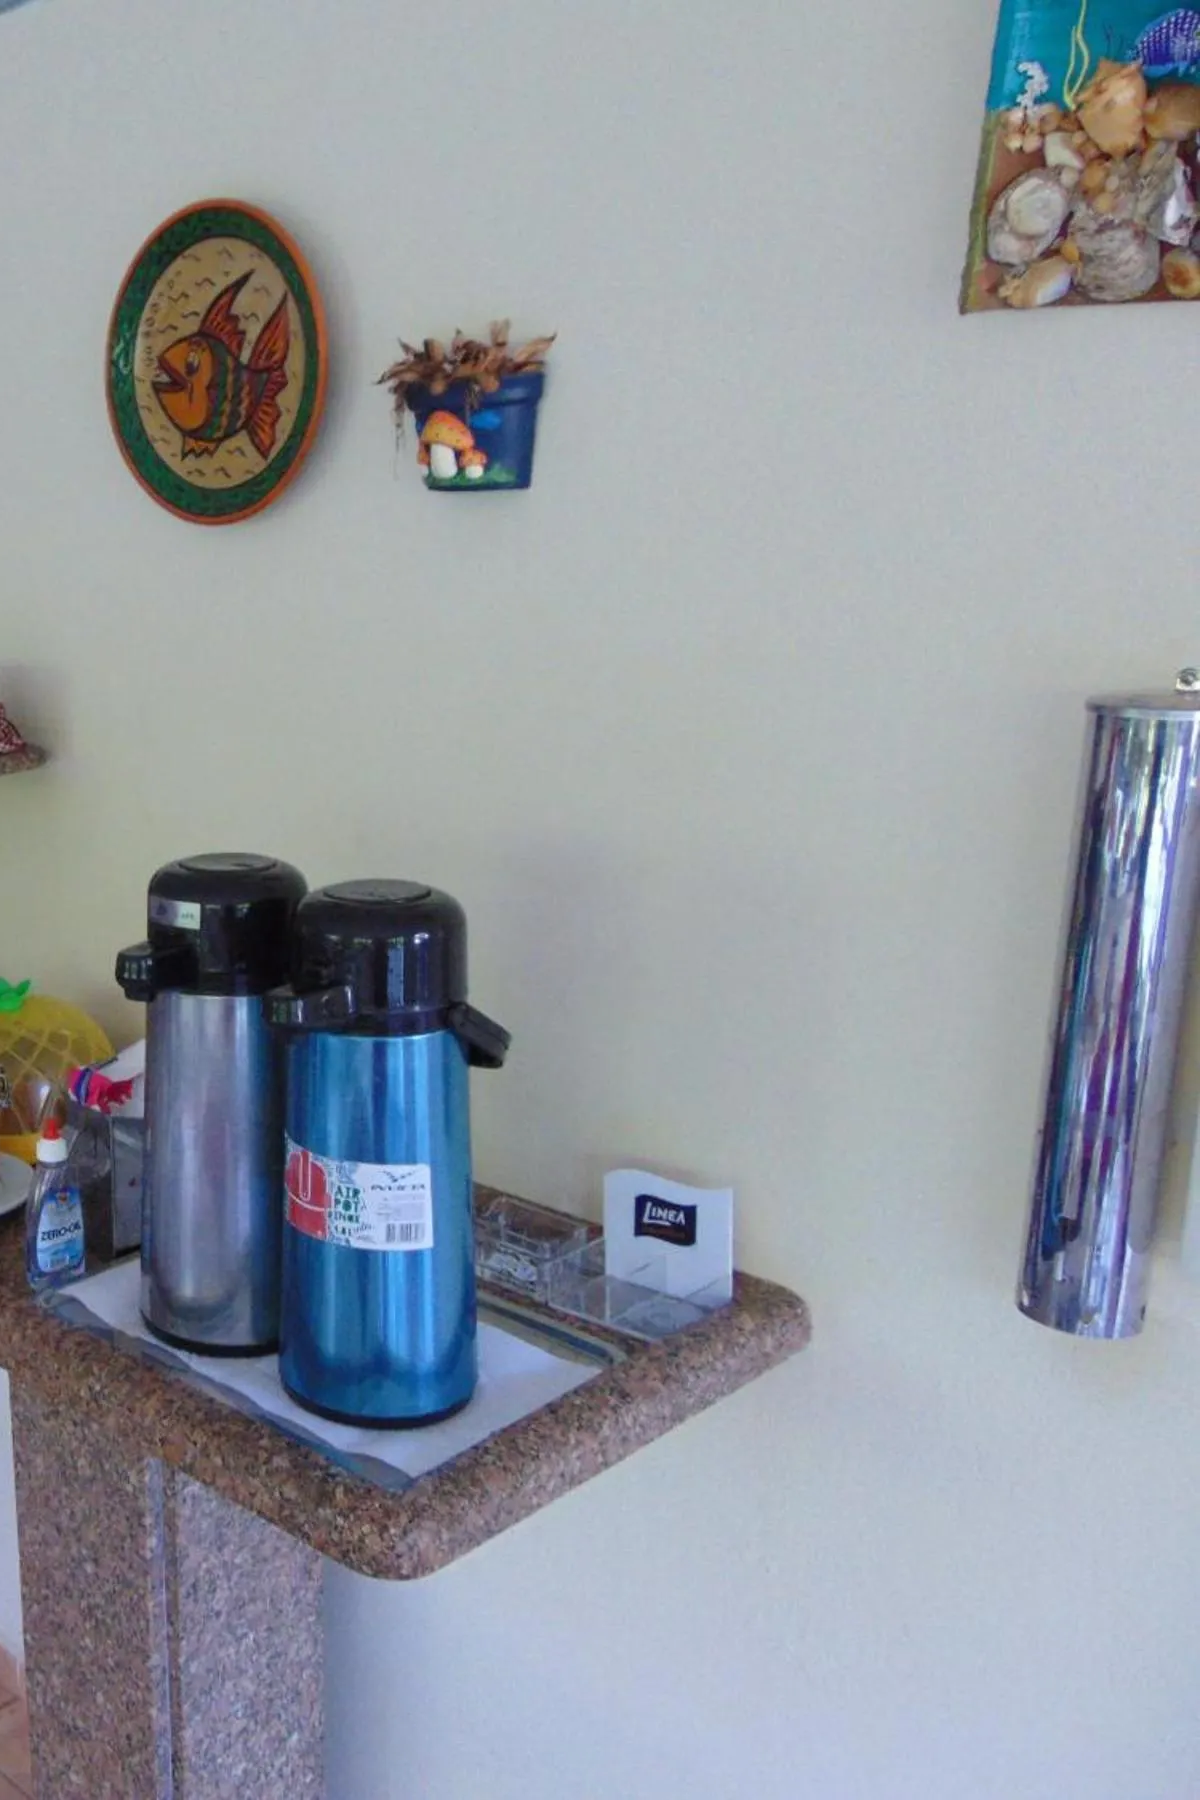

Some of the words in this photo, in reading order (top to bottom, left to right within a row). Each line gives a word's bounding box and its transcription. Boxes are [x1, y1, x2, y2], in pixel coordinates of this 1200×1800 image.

[334, 1186, 361, 1199] AIR
[334, 1199, 360, 1212] POT
[642, 1200, 686, 1226] LINEA
